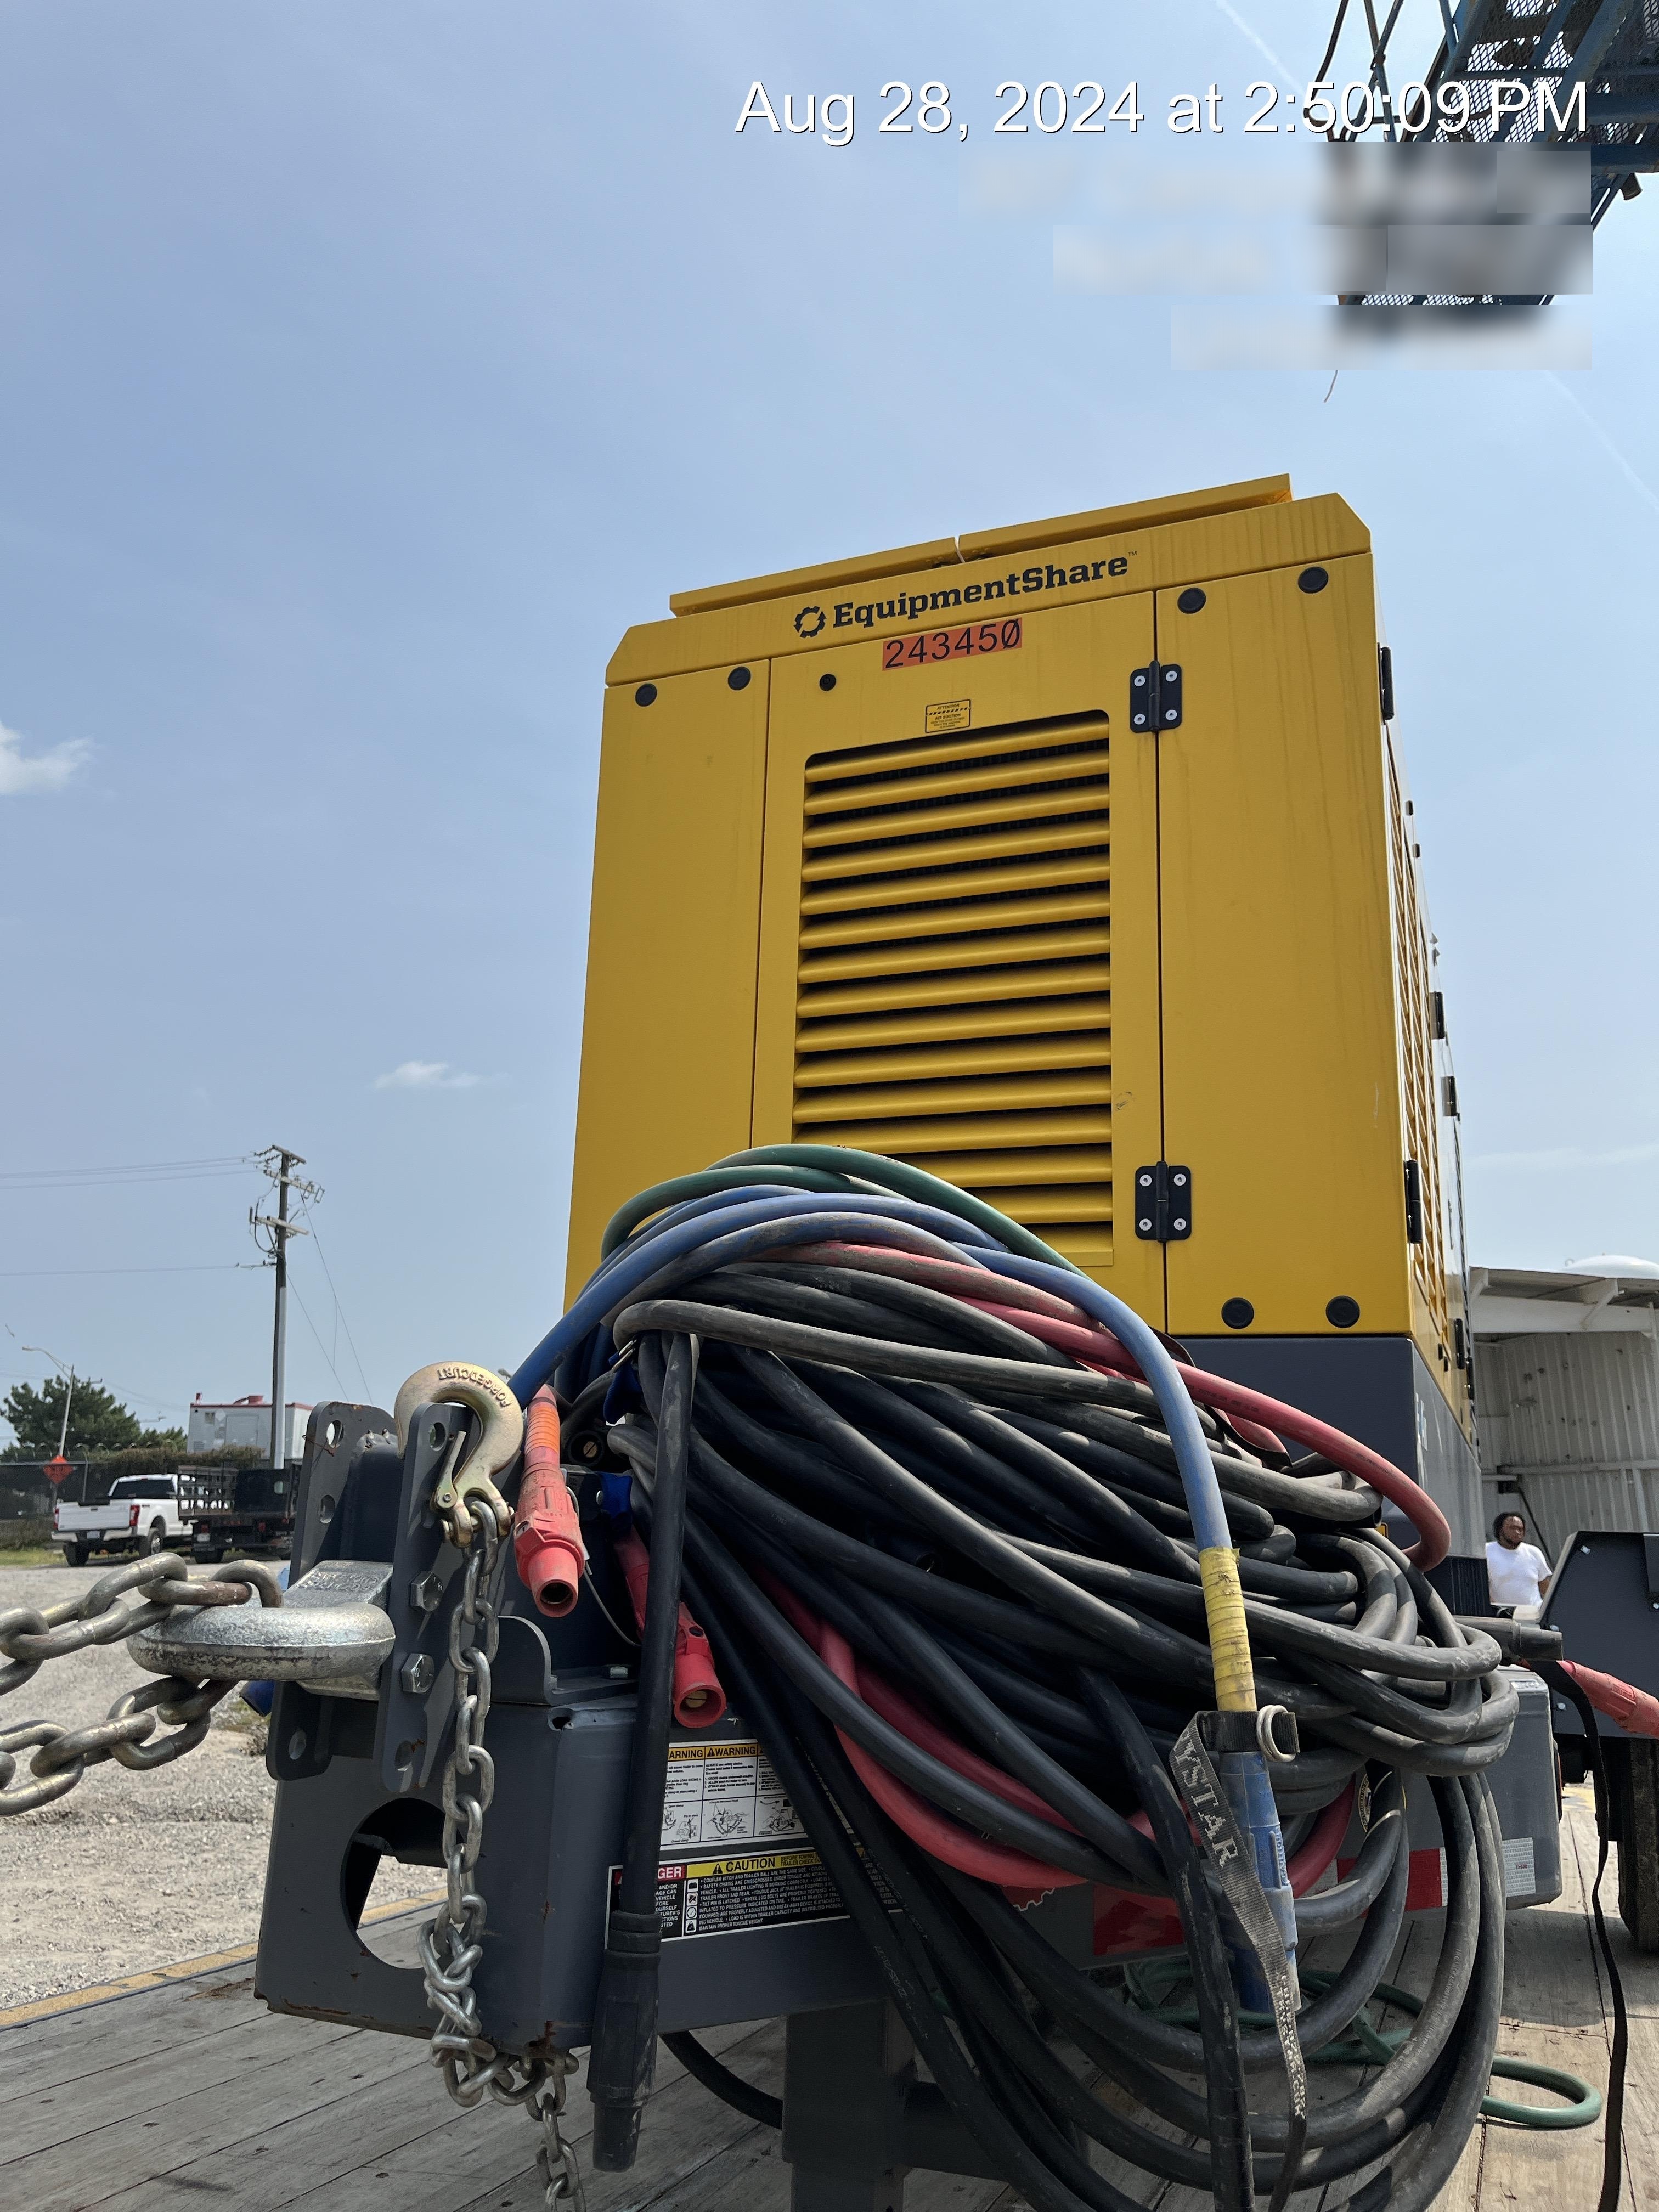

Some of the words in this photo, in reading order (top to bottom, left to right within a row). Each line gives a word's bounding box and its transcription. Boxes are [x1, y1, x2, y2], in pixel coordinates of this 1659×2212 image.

[833, 556, 1128, 628] EquipmentShare
[885, 619, 1022, 669] 243450
[669, 1750, 703, 1759] ARNING
[715, 1747, 755, 1756] WARNING
[726, 1857, 775, 1872] CAUTION
[658, 1866, 682, 1879] GER
